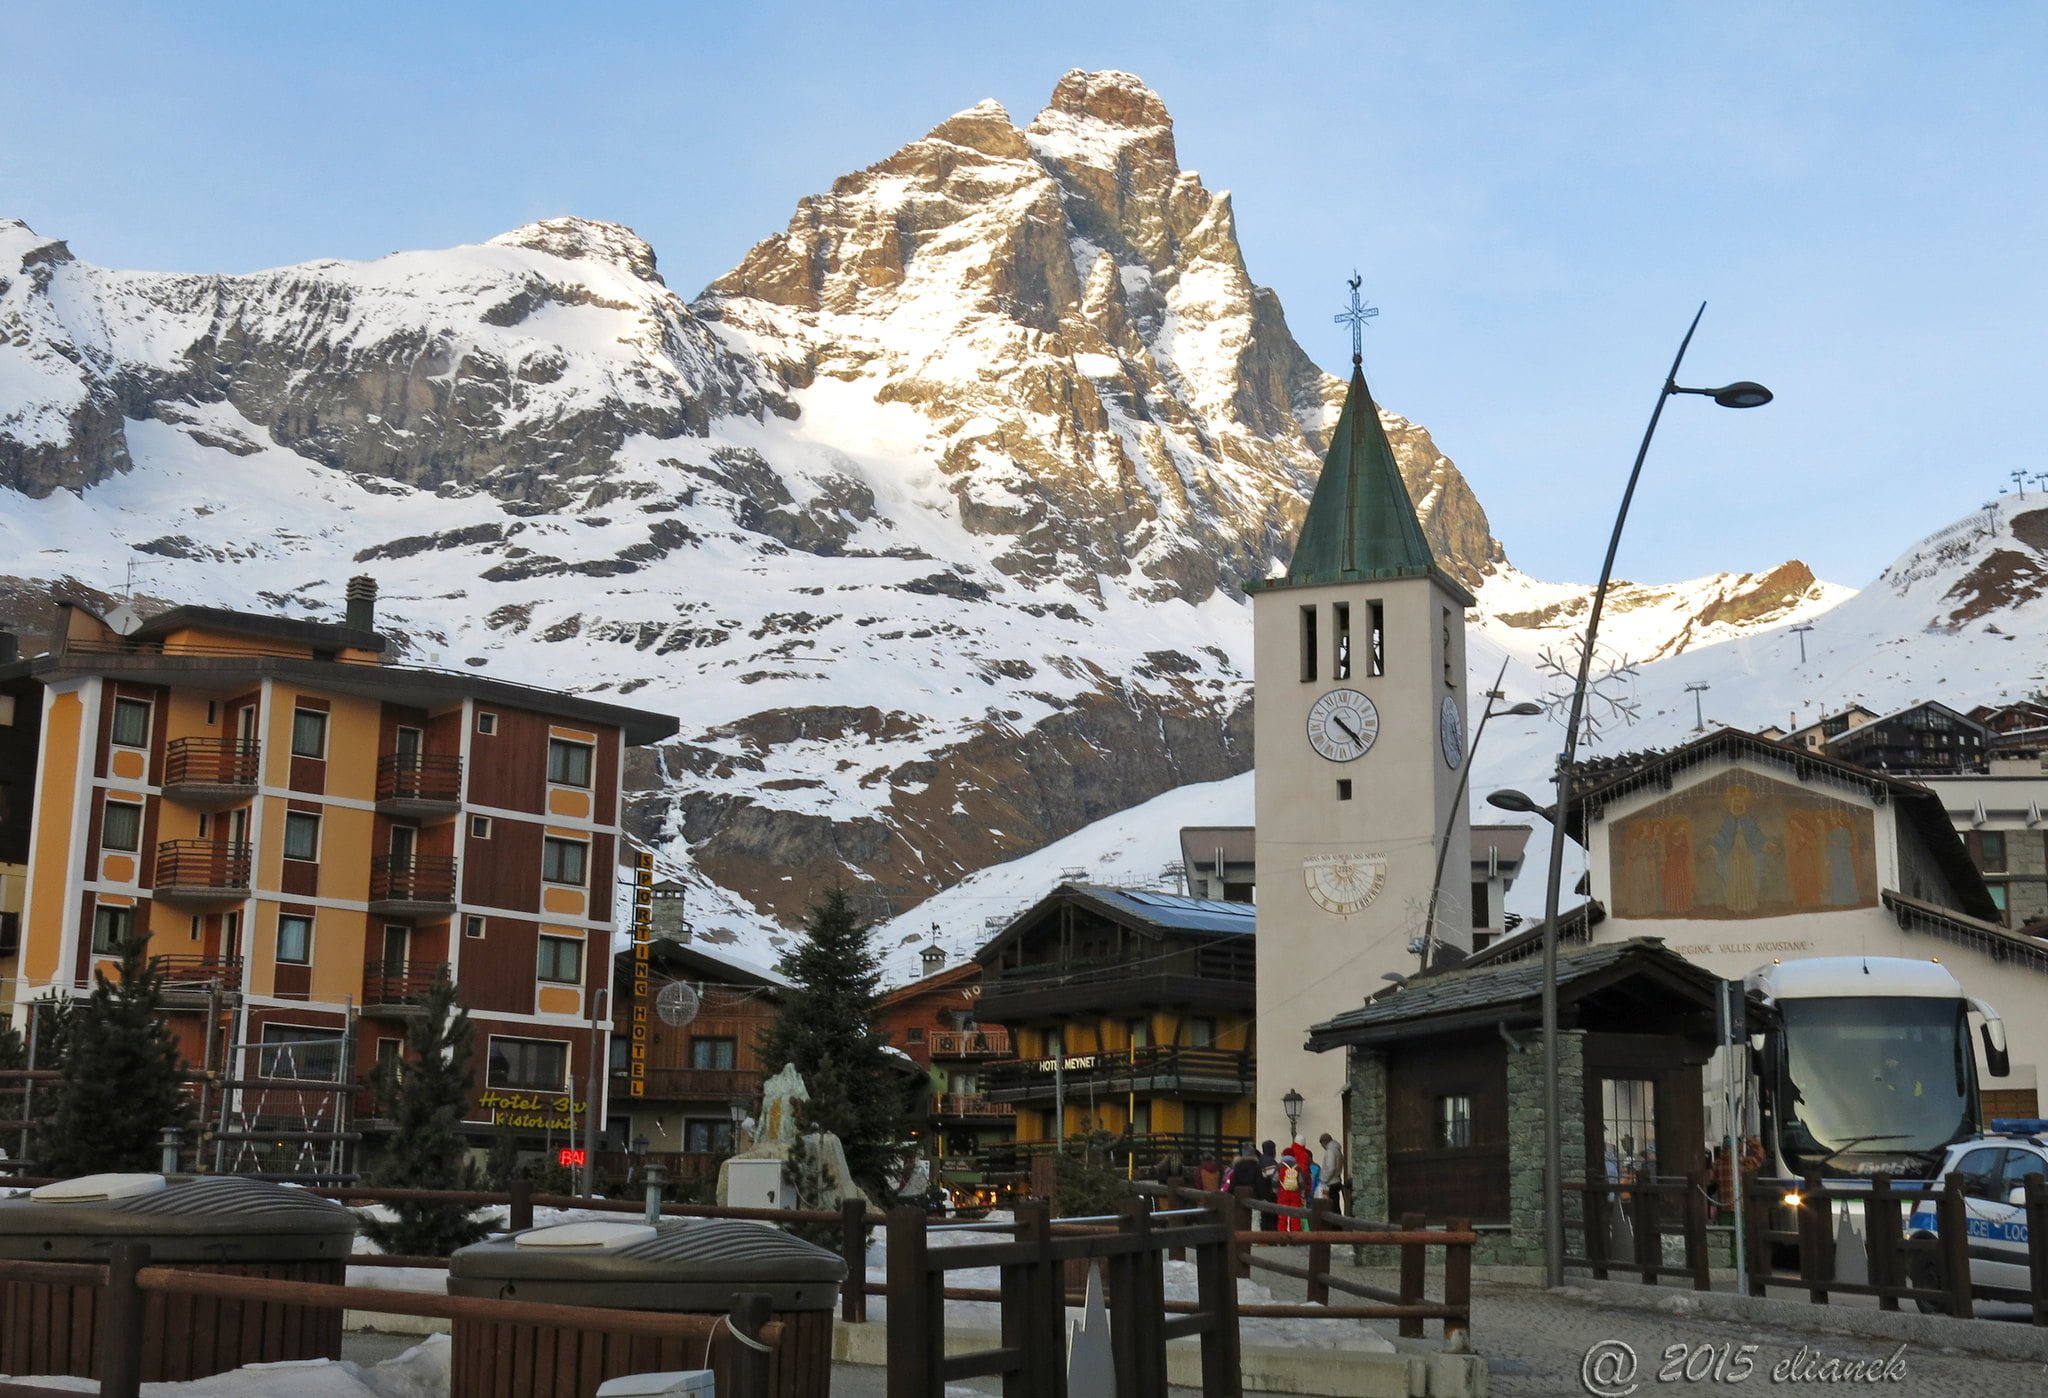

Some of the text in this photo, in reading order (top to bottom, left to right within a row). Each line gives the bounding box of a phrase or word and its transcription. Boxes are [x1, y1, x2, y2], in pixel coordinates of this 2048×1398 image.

[1719, 943, 1752, 954] VALLIS
[632, 854, 651, 1095] SPORTING HOTEL
[1040, 1057, 1096, 1072] HOTE MEYNET
[479, 1091, 542, 1111] Hotel
